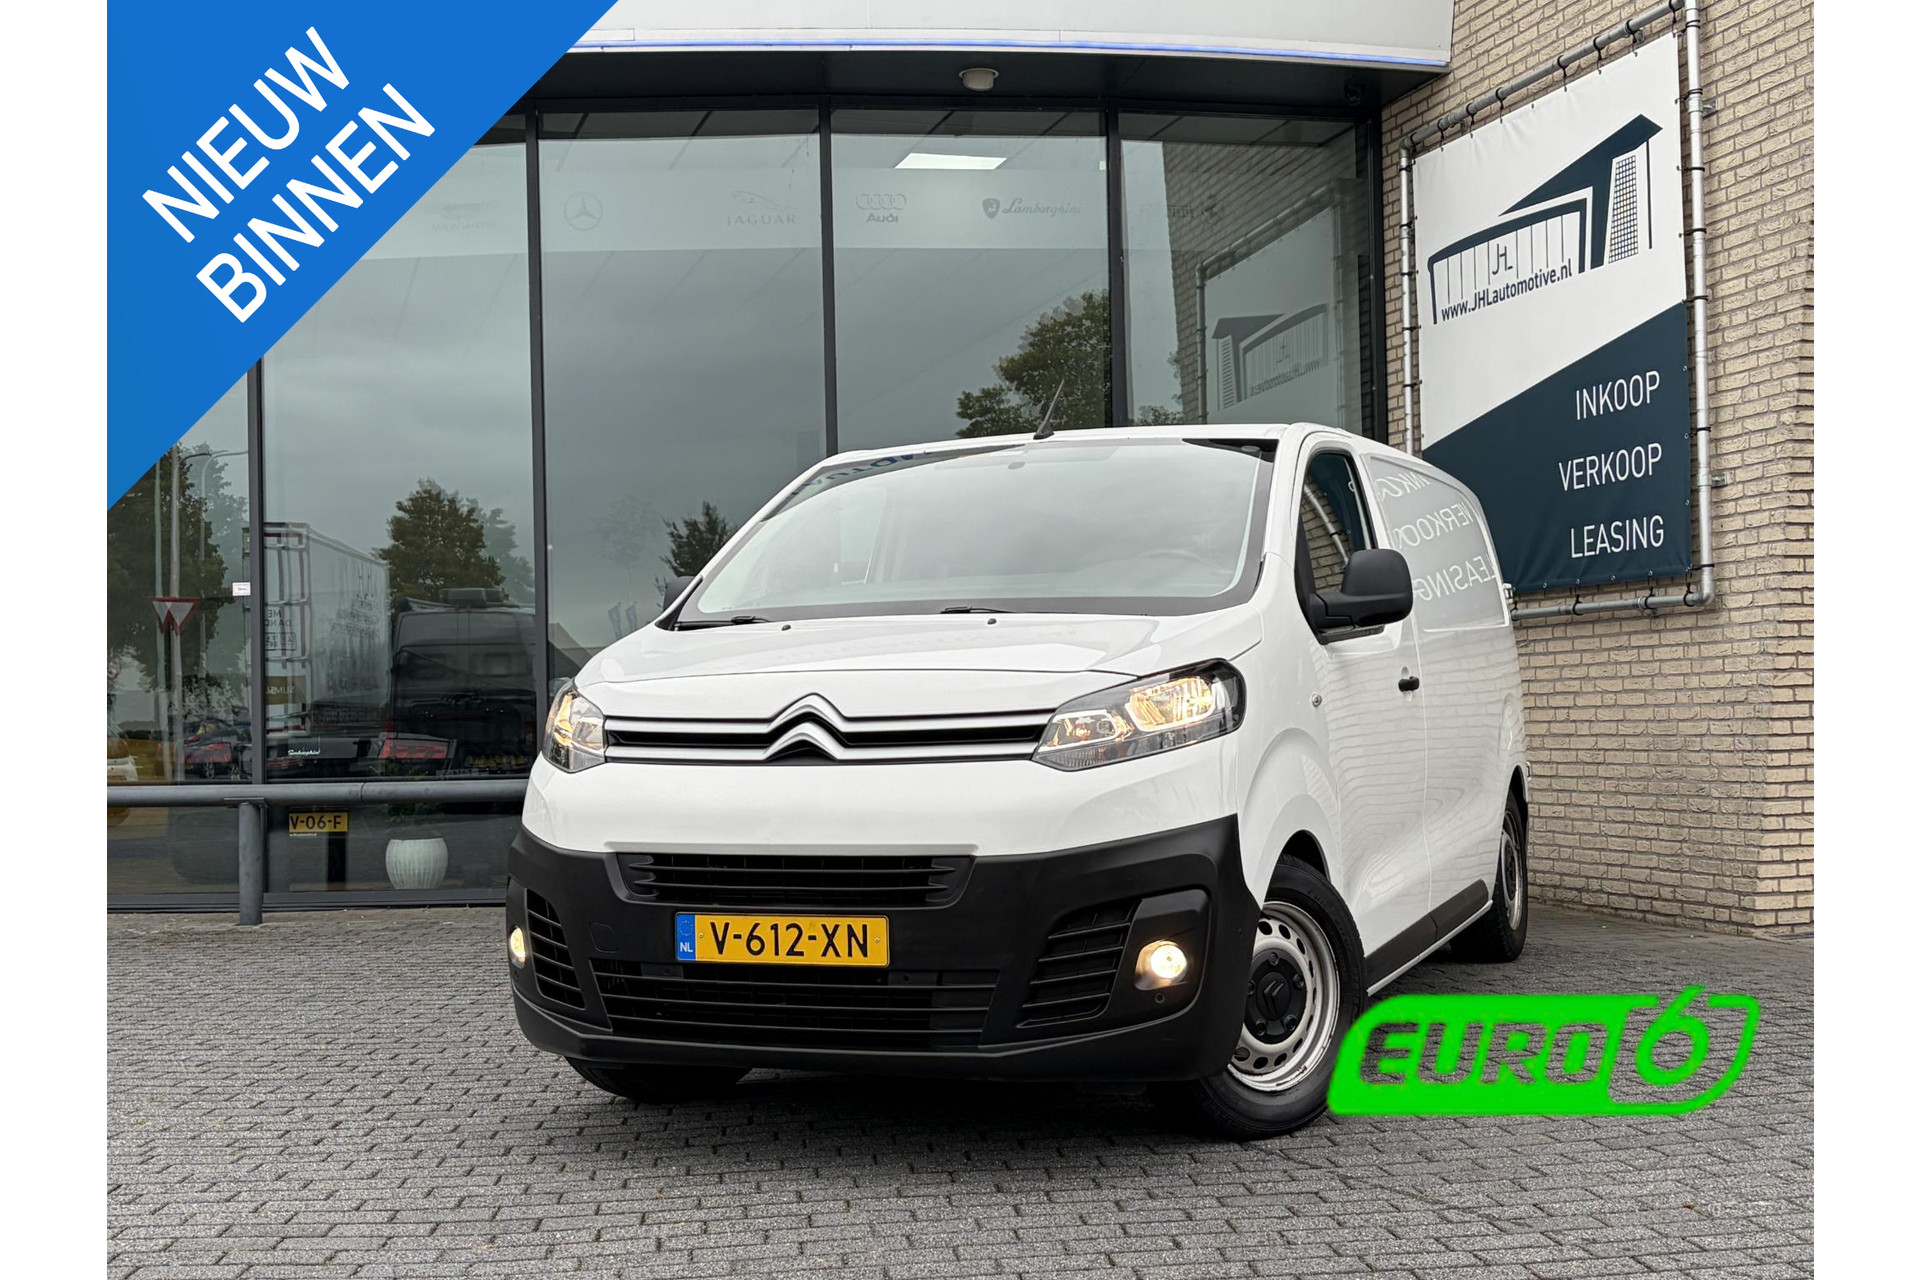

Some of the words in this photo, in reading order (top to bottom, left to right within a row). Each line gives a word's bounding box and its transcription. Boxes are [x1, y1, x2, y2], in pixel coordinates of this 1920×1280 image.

[726, 213, 797, 228] JAGUAR
[1441, 257, 1573, 322] www.JHLautomotive.nl
[1575, 370, 1661, 421] INKOOP
[1558, 442, 1663, 492] VERKOOP
[1570, 515, 1664, 560] LEASING
[290, 814, 342, 830] V-06-F
[679, 942, 694, 954] NL
[709, 921, 869, 958] V-612-XN
